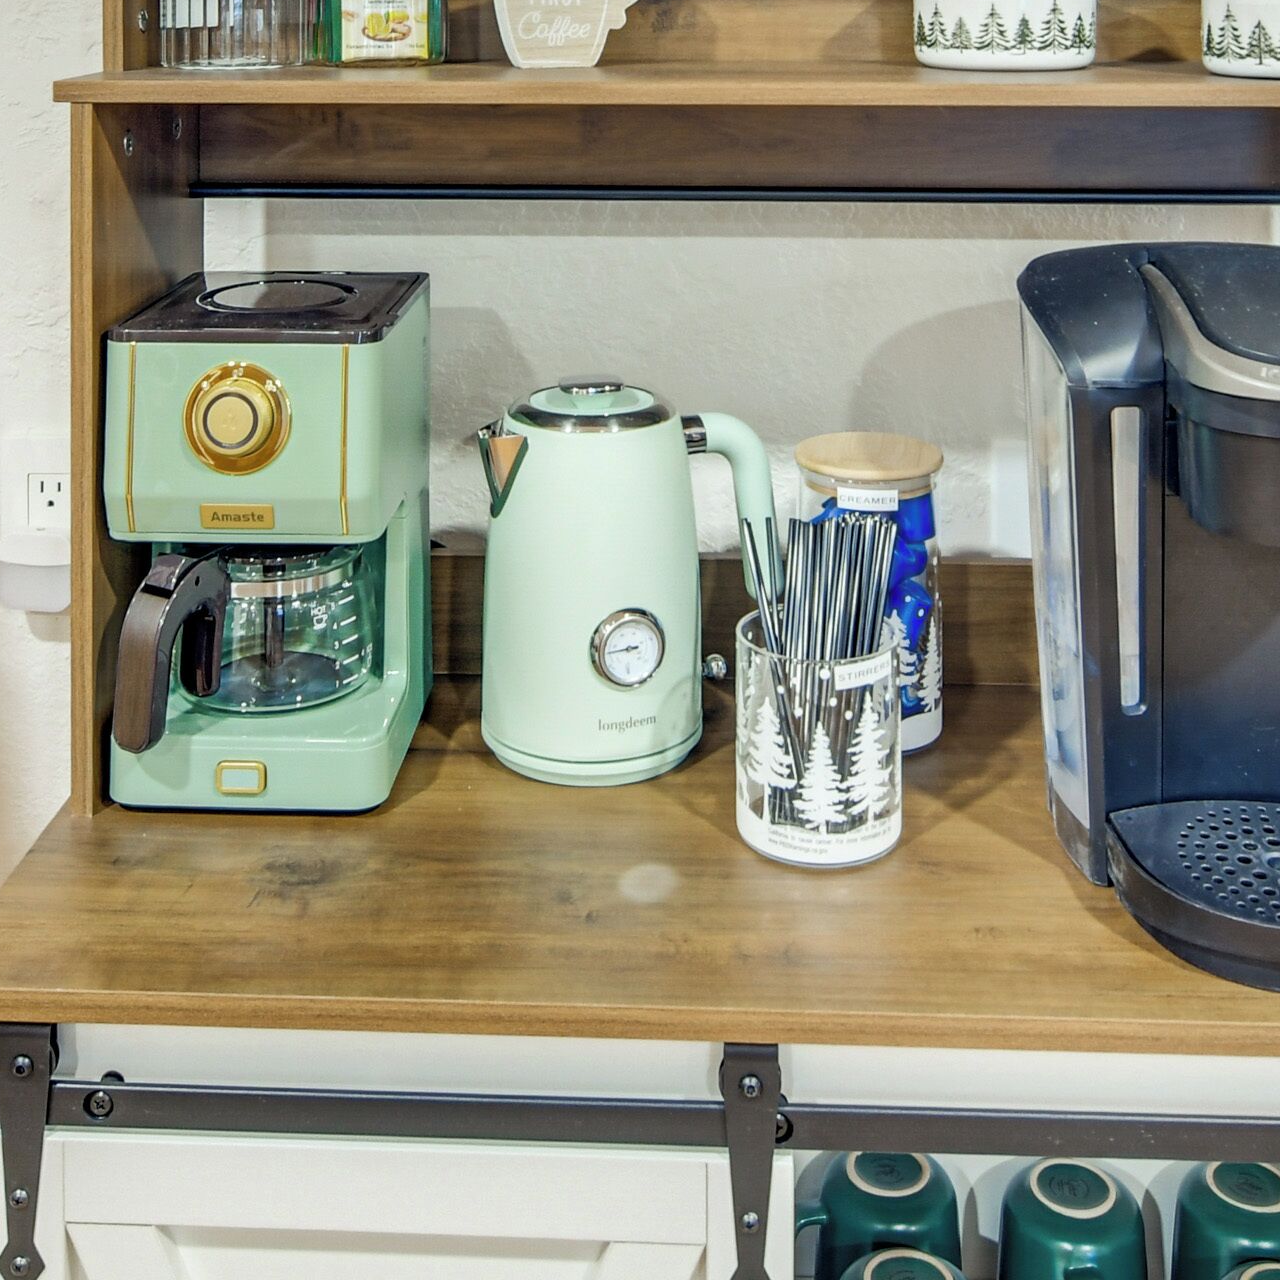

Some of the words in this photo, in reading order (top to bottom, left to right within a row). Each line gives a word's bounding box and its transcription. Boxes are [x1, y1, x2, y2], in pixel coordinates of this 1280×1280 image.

[518, 10, 591, 47] Coffee
[839, 494, 896, 505] CREAMER
[210, 511, 265, 522] Amaste
[598, 715, 657, 733] longdeem
